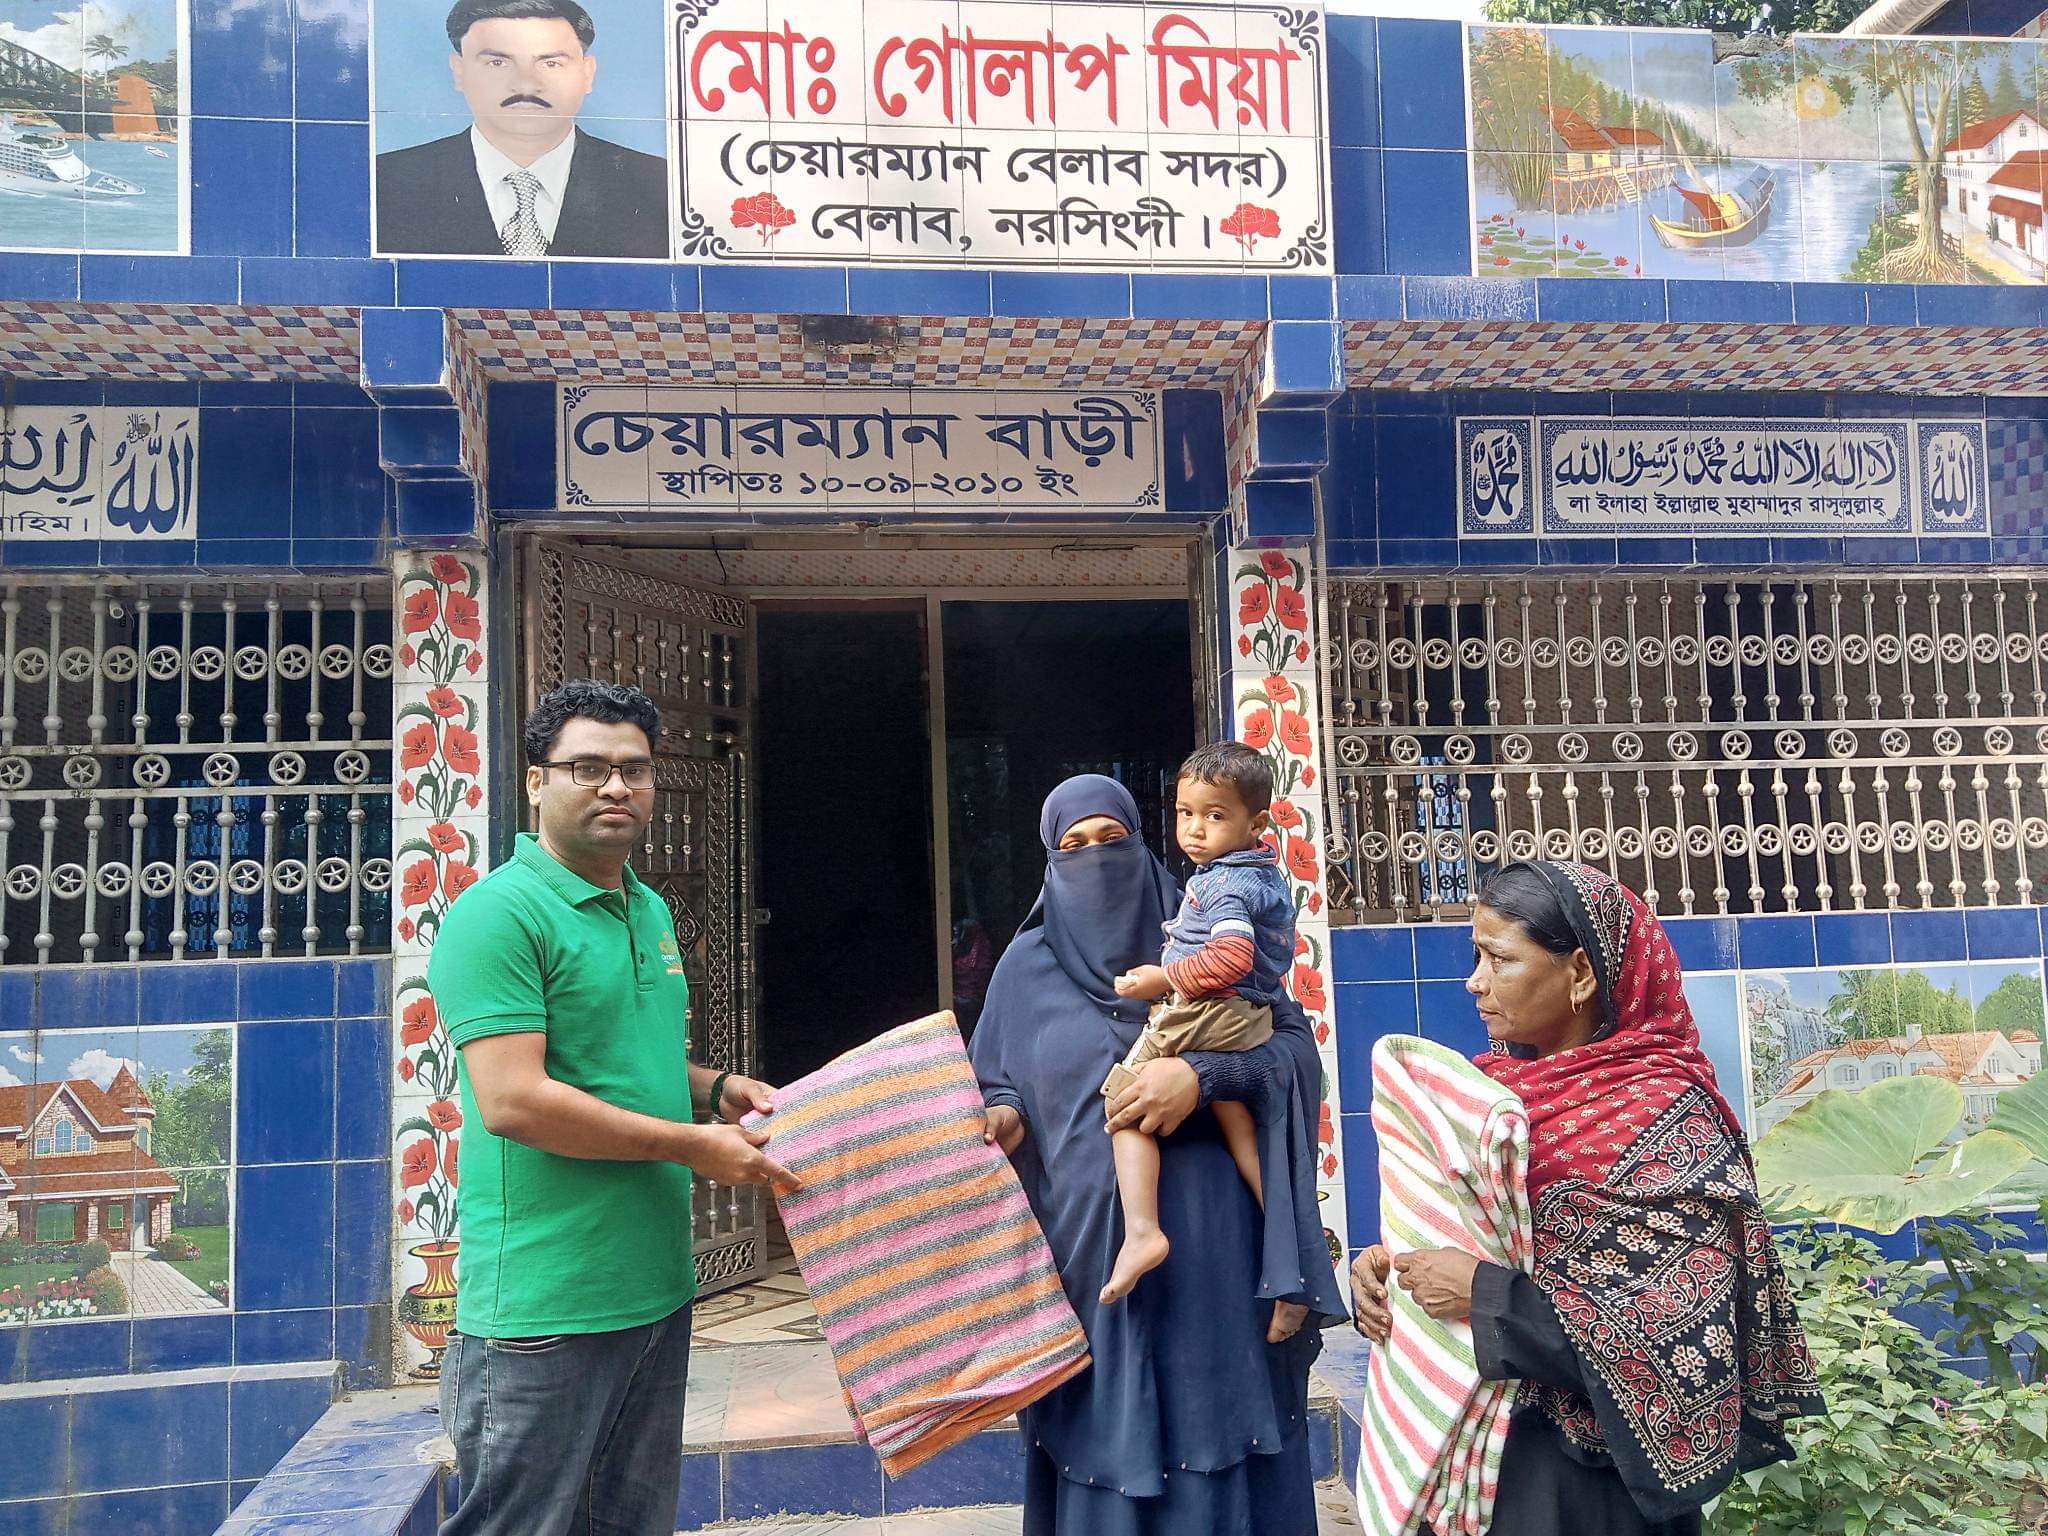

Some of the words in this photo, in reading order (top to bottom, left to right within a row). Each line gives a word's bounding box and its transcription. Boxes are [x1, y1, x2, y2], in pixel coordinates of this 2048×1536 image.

[691, 20, 836, 119] মোঃ
[874, 23, 1129, 125] গোলাপ
[1146, 14, 1302, 134] মিয়া
[720, 133, 990, 186] (চেয়ারম্যান
[1007, 146, 1148, 187] বেলাব
[1163, 146, 1287, 199] সদর)
[811, 200, 972, 253] বেলাব,
[989, 197, 1185, 250] নরসিংদী
[573, 406, 960, 460] চেয়ারম্যান
[976, 397, 1148, 468] বাড়ী
[656, 463, 783, 499] স্থাপিতঃ
[799, 471, 1023, 497] ১০-০৯-২০১০
[1035, 464, 1079, 496] ইং
[1567, 494, 1591, 514] লা
